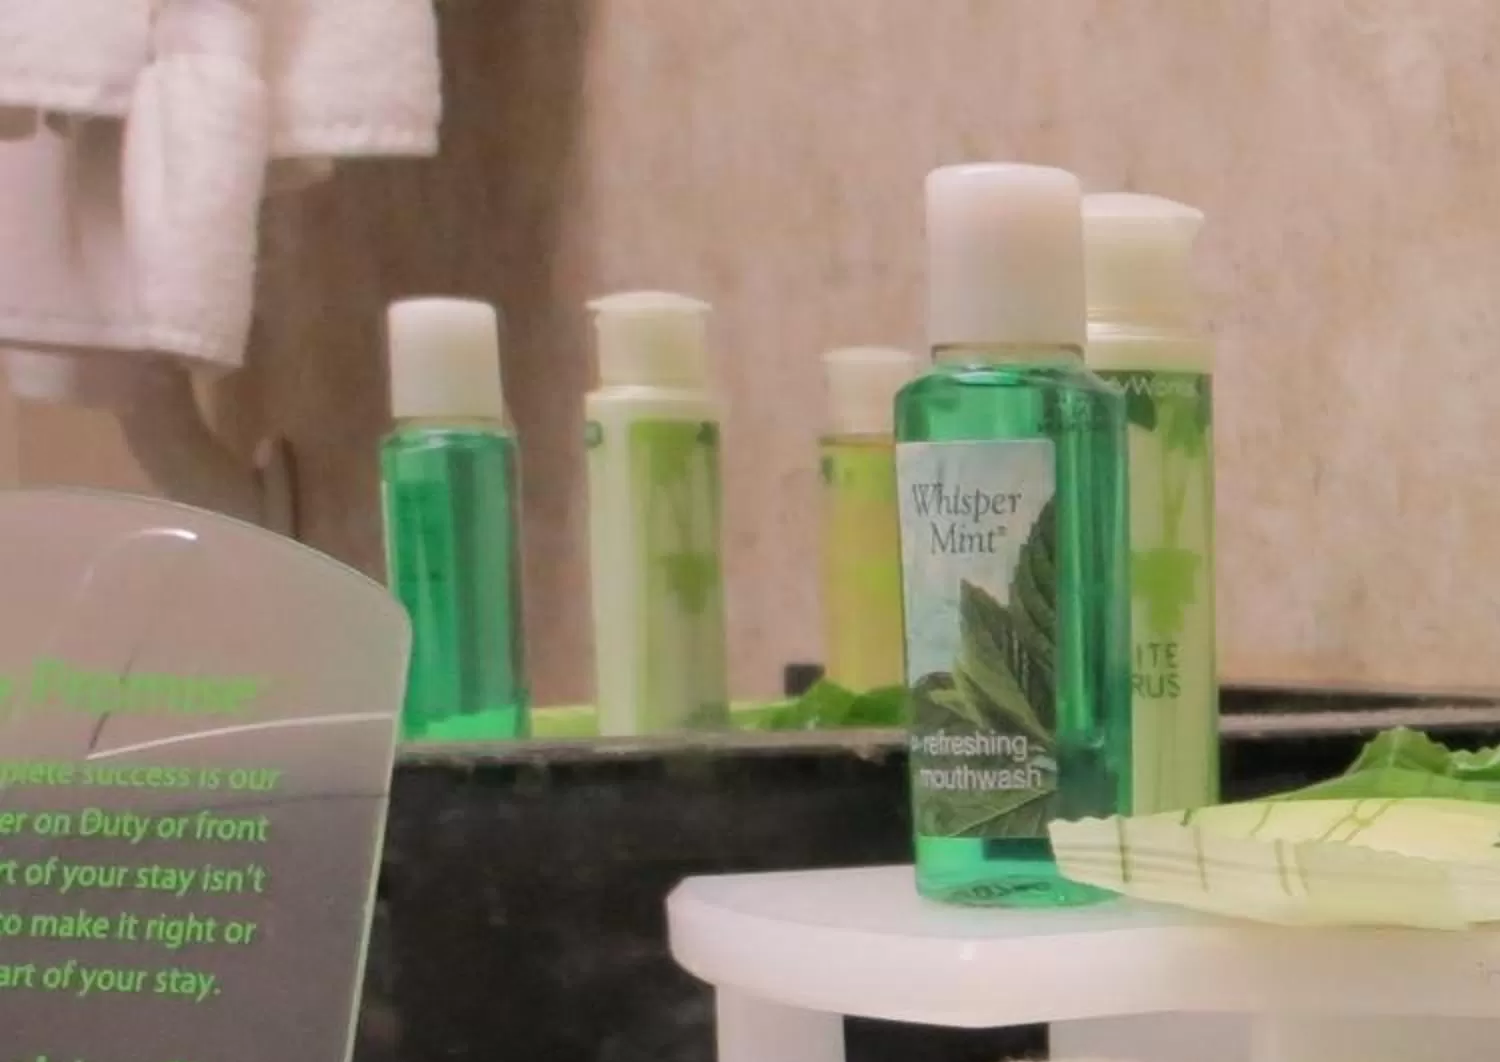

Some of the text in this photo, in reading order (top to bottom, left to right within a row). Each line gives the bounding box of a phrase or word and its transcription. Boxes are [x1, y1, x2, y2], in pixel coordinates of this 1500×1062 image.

[911, 482, 1022, 523] Whisper
[923, 728, 1027, 763] refreshing
[83, 765, 190, 788] success
[200, 766, 220, 789] is
[229, 768, 282, 791] our
[0, 807, 269, 845] er on Duty or front
[24, 856, 58, 886] of
[59, 865, 129, 895] your
[136, 864, 195, 896] stay
[203, 865, 266, 893] isn't
[31, 907, 110, 939] make
[118, 911, 139, 941] it
[146, 913, 216, 948] right
[225, 922, 257, 944] or
[0, 959, 222, 1002] art of your stay.
